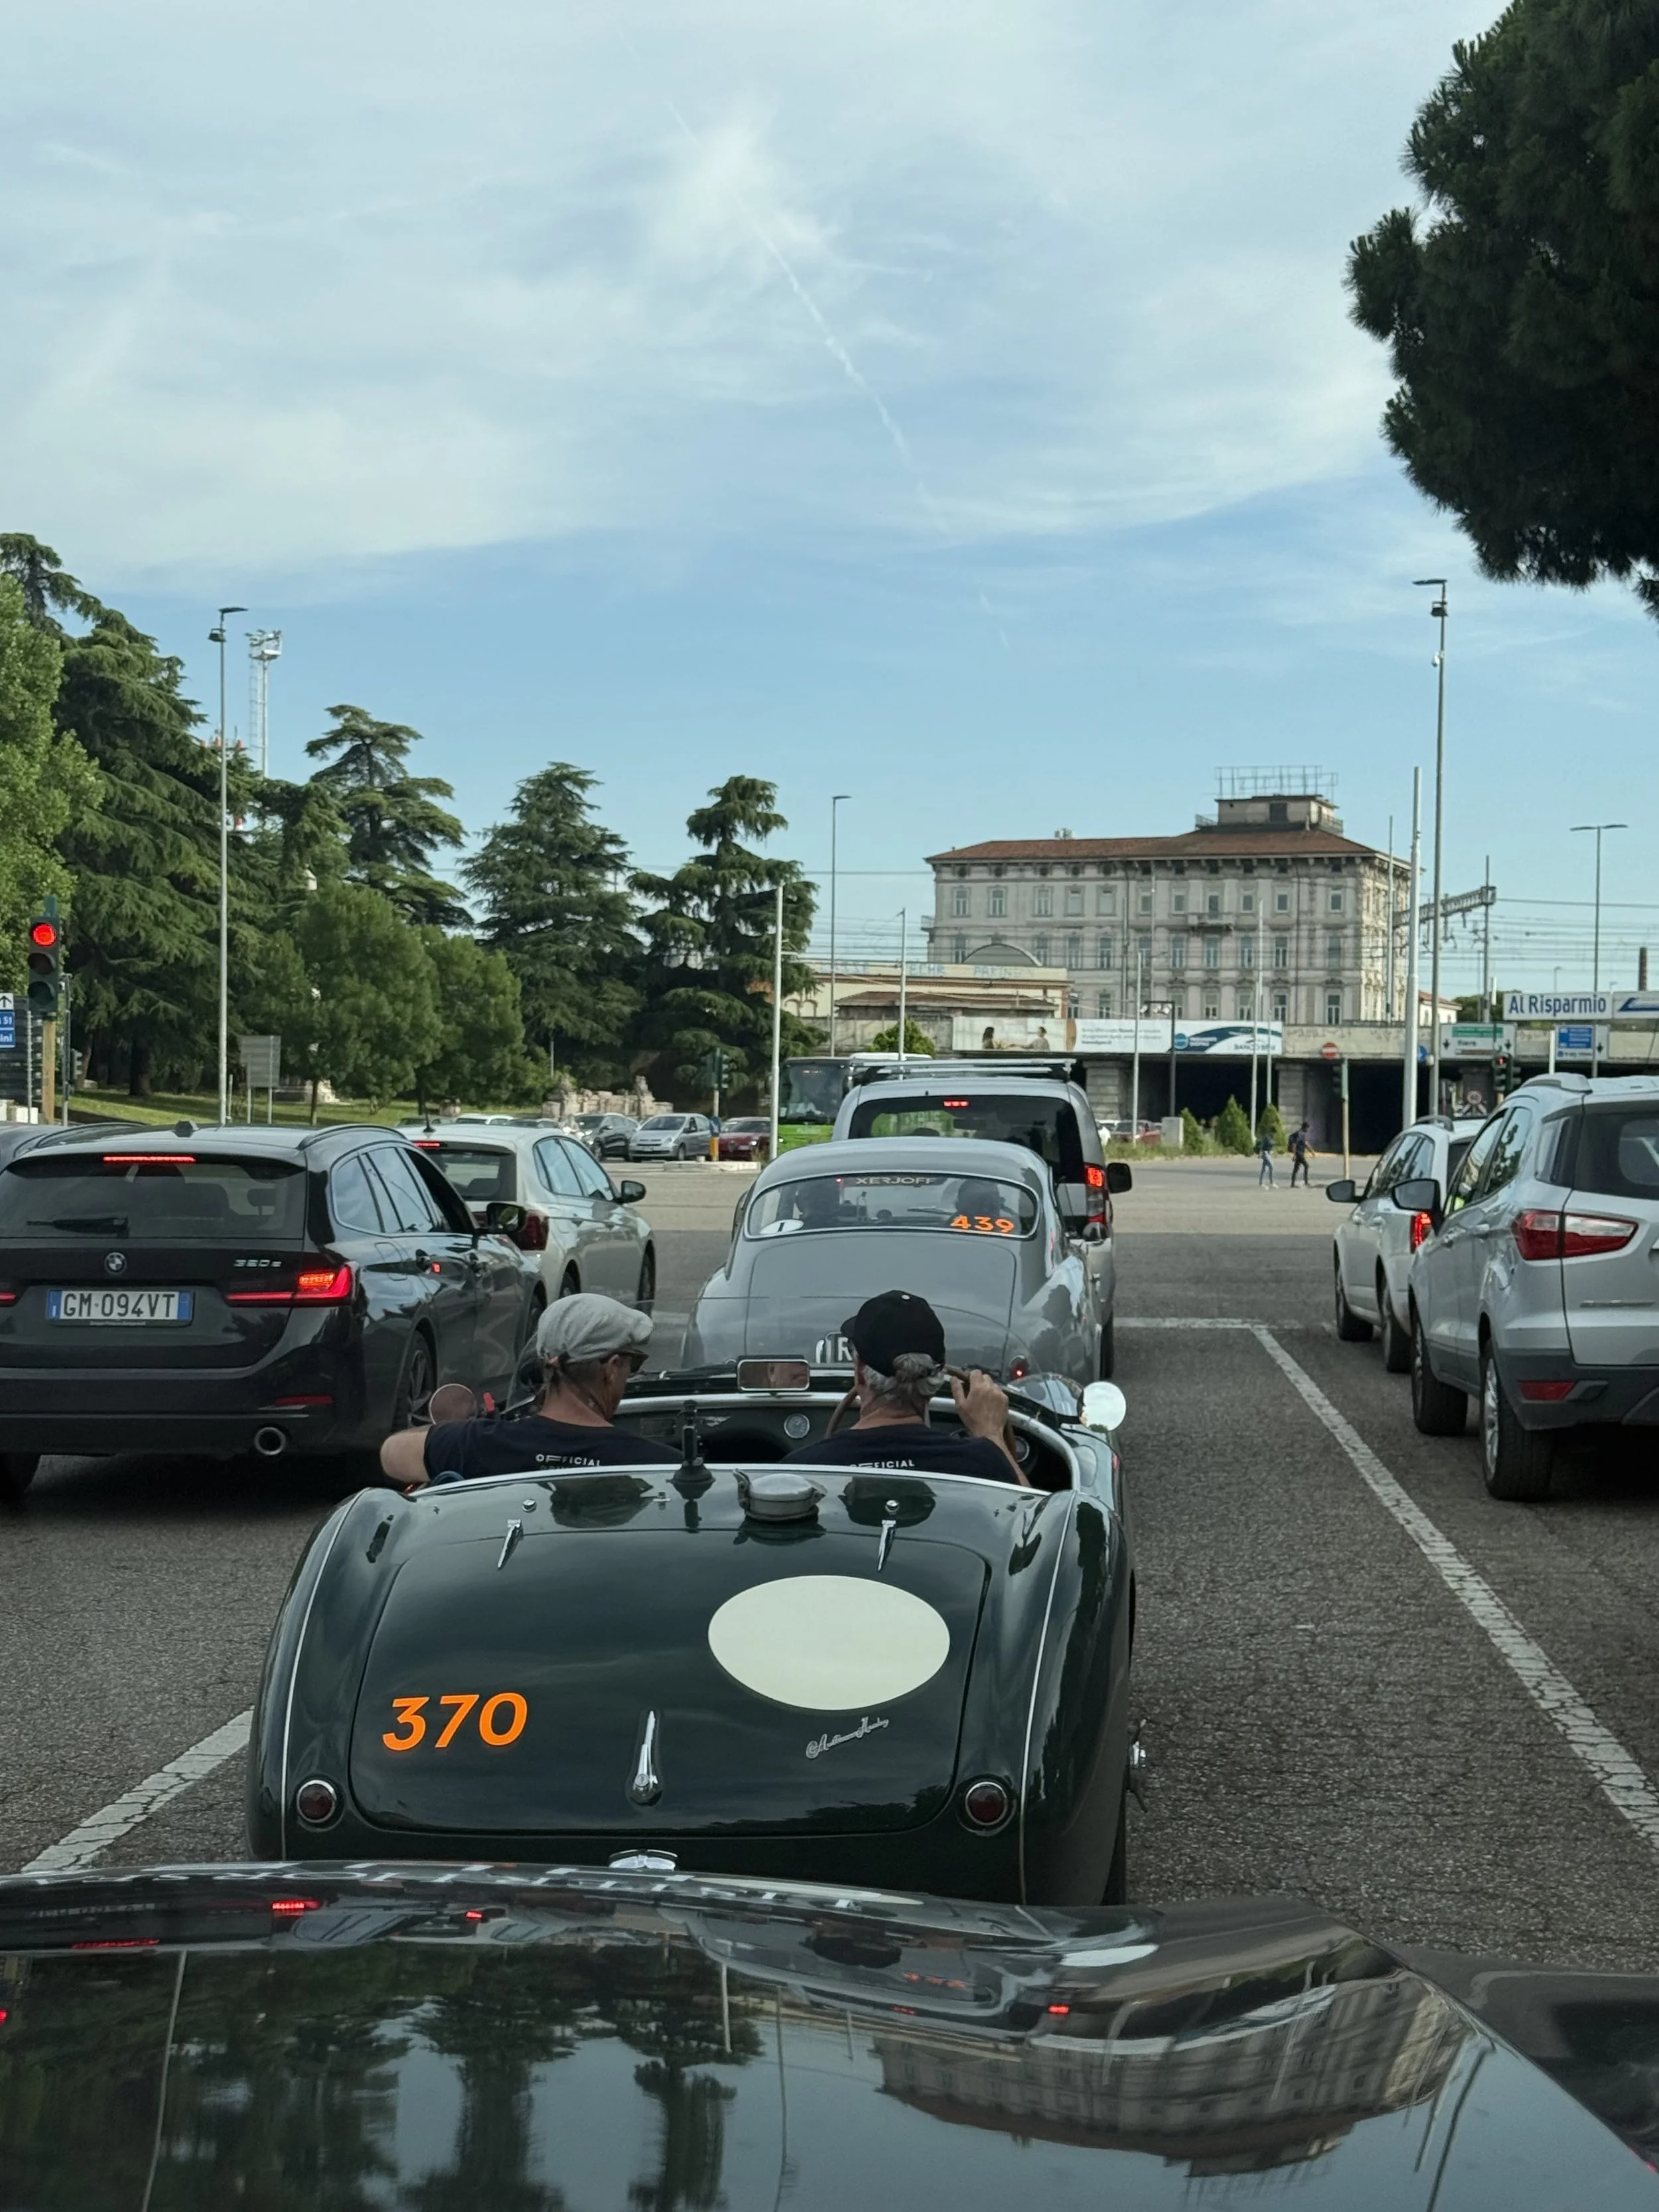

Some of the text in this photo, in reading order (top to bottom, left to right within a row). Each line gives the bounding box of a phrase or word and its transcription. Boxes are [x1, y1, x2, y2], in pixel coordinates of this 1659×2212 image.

[1508, 995, 1607, 1017] Al Risparmio
[855, 1176, 936, 1185] XERJOFF
[950, 1215, 1014, 1233] 439
[536, 1453, 600, 1467] OFFICIAL
[382, 1692, 528, 1751] 370
